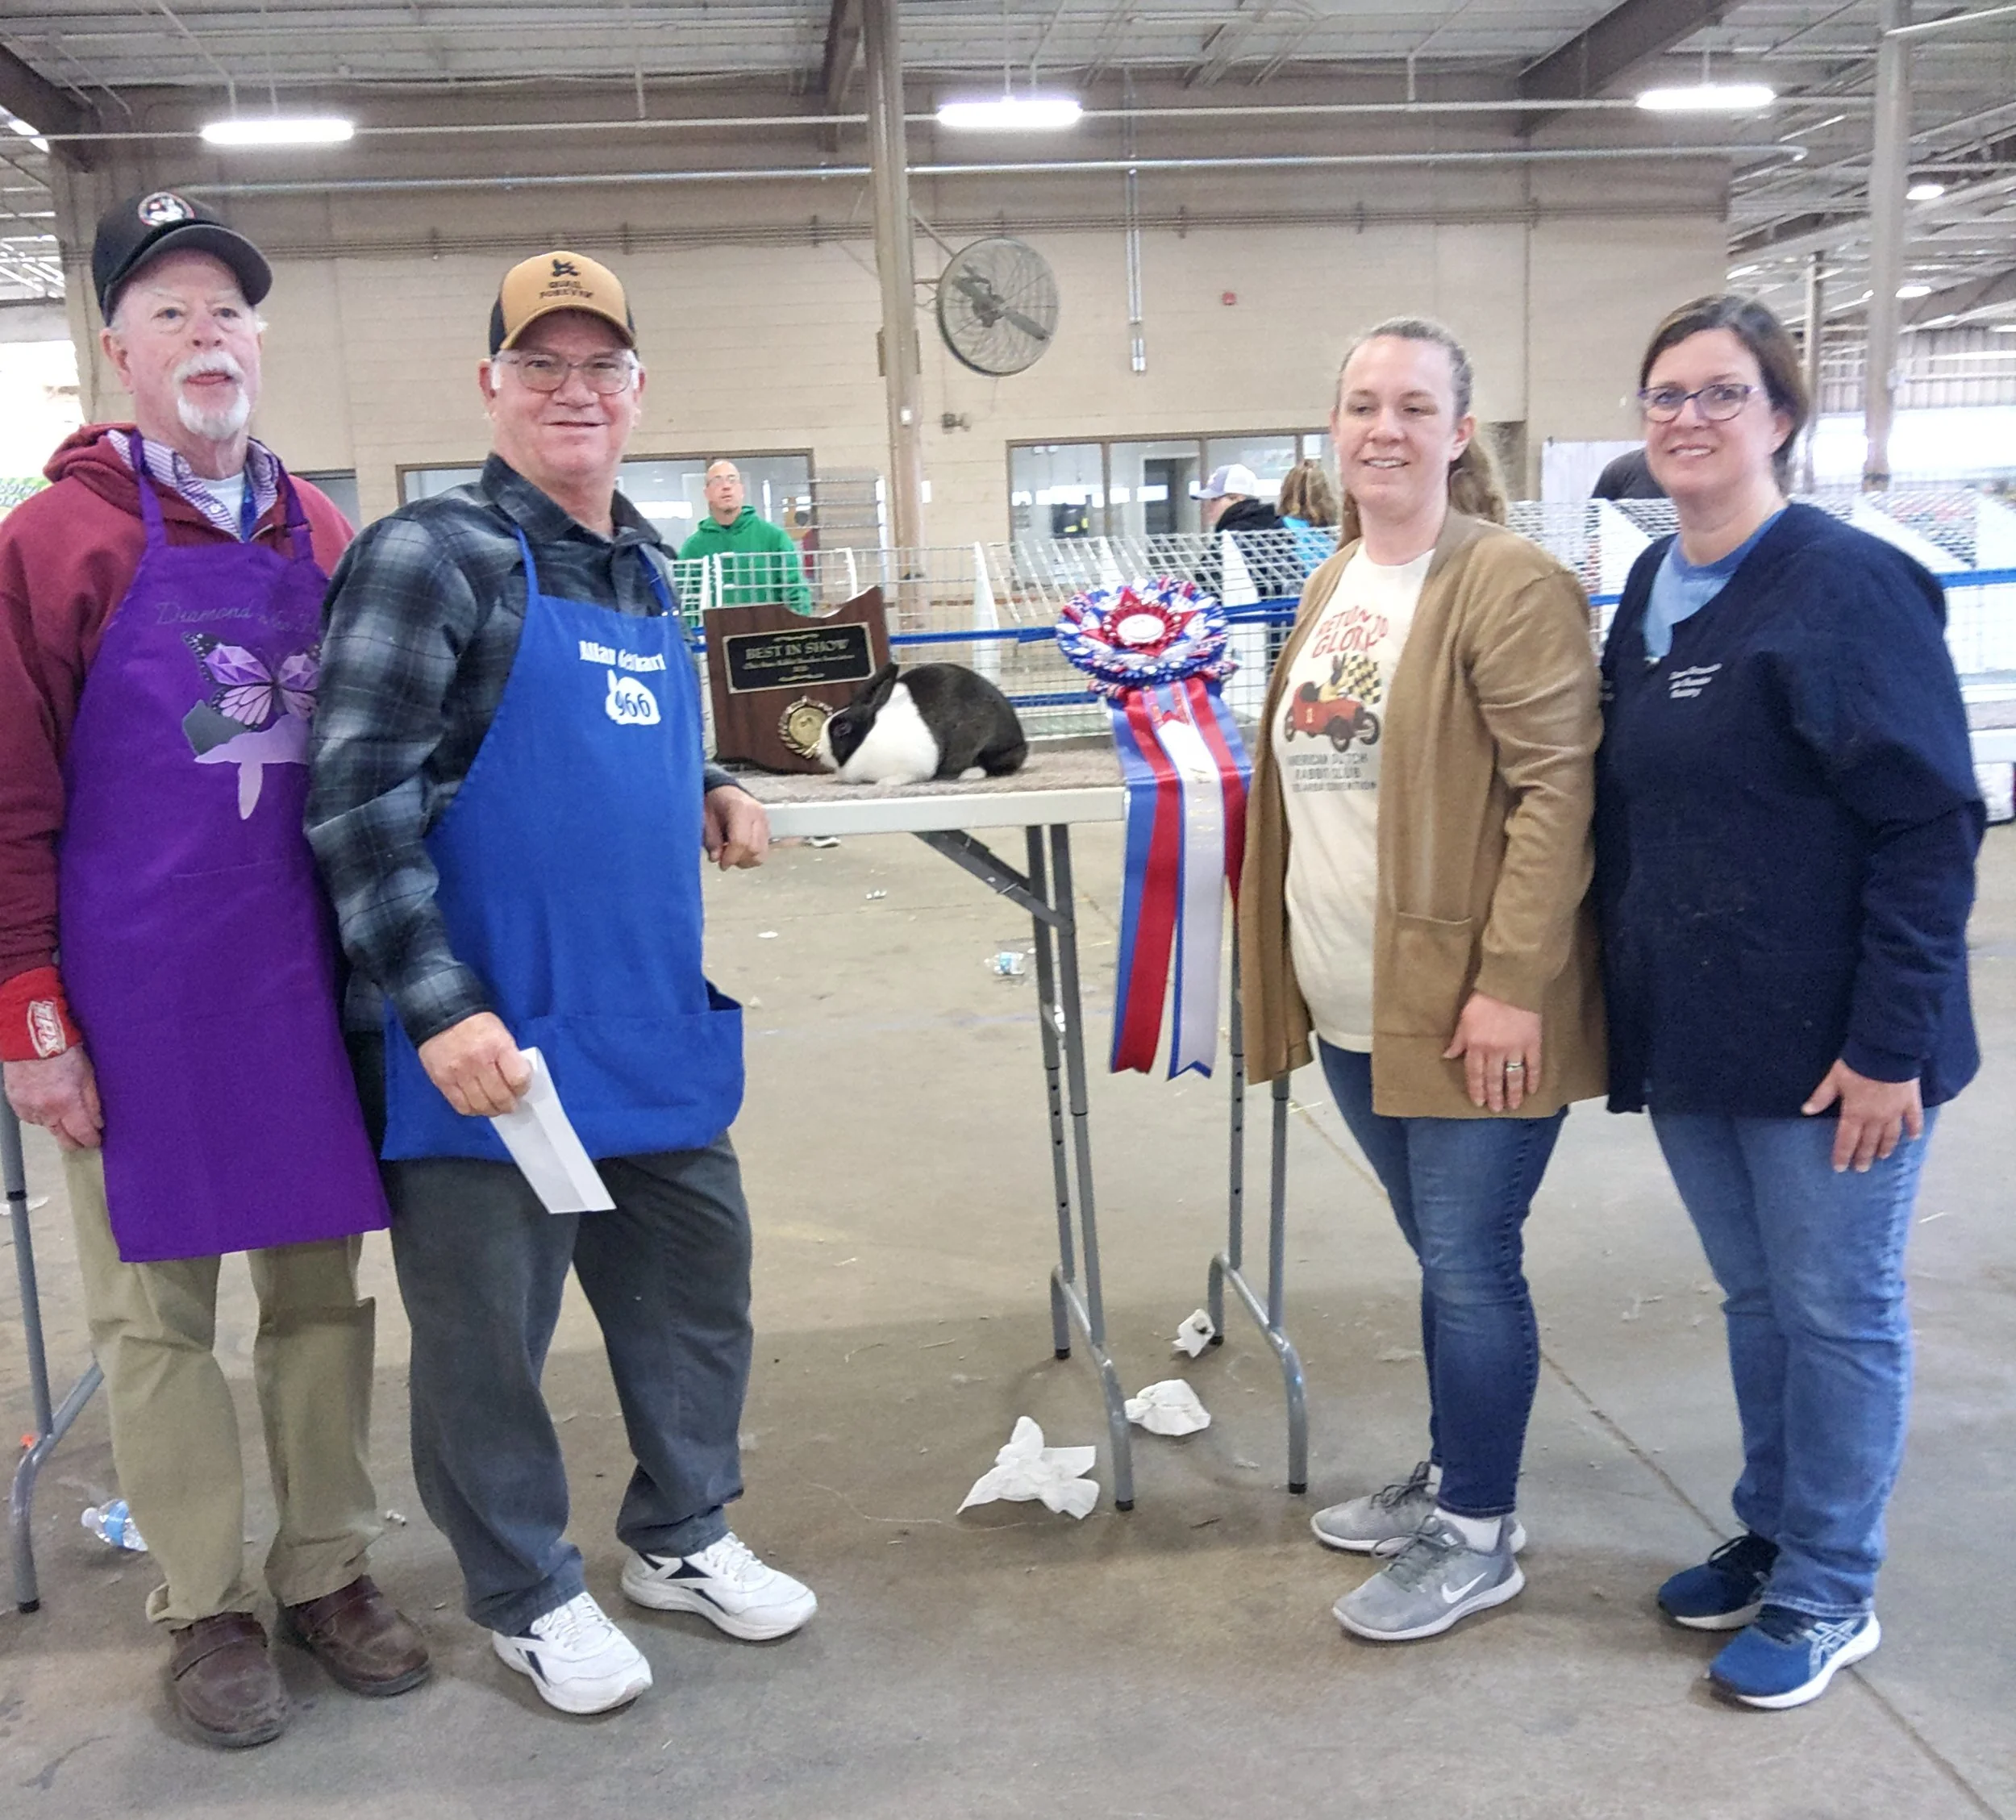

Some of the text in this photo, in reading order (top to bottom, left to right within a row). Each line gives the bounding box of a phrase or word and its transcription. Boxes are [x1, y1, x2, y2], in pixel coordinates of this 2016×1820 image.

[746, 639, 850, 660] BEST IN SHOW
[614, 690, 651, 717] 966
